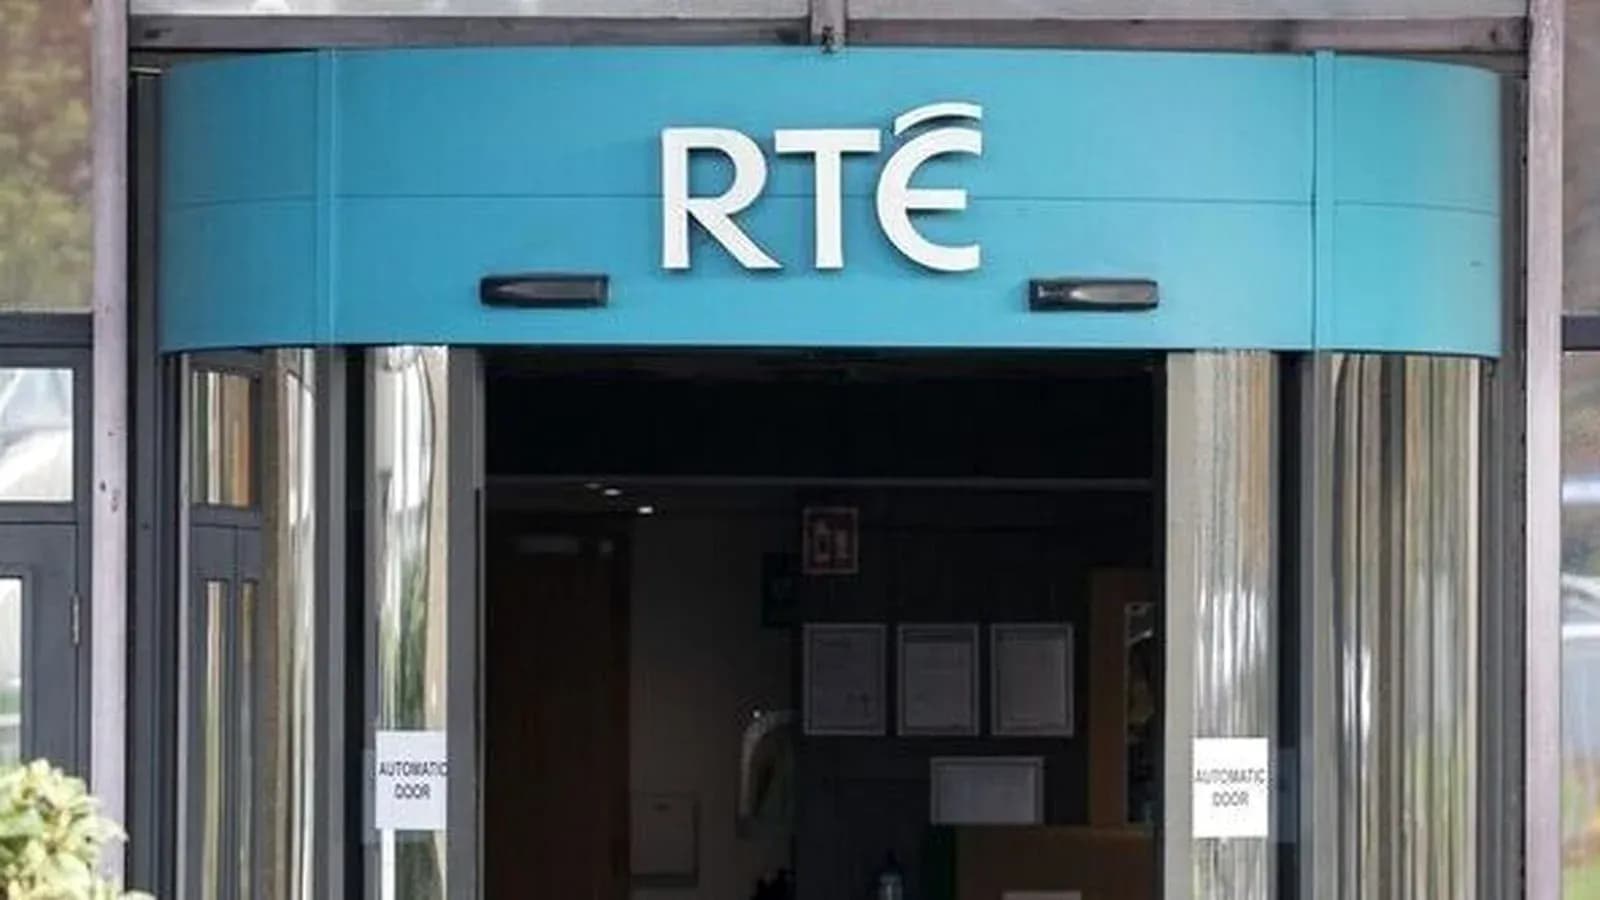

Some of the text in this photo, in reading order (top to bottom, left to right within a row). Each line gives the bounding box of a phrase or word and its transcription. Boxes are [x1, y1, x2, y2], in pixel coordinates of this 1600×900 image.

[661, 101, 983, 272] RTÉ
[379, 761, 448, 777] AUTOMATIC
[1195, 768, 1265, 784] AUTOMATIC
[394, 783, 430, 800] DOOR
[1212, 791, 1250, 808] DOOR
